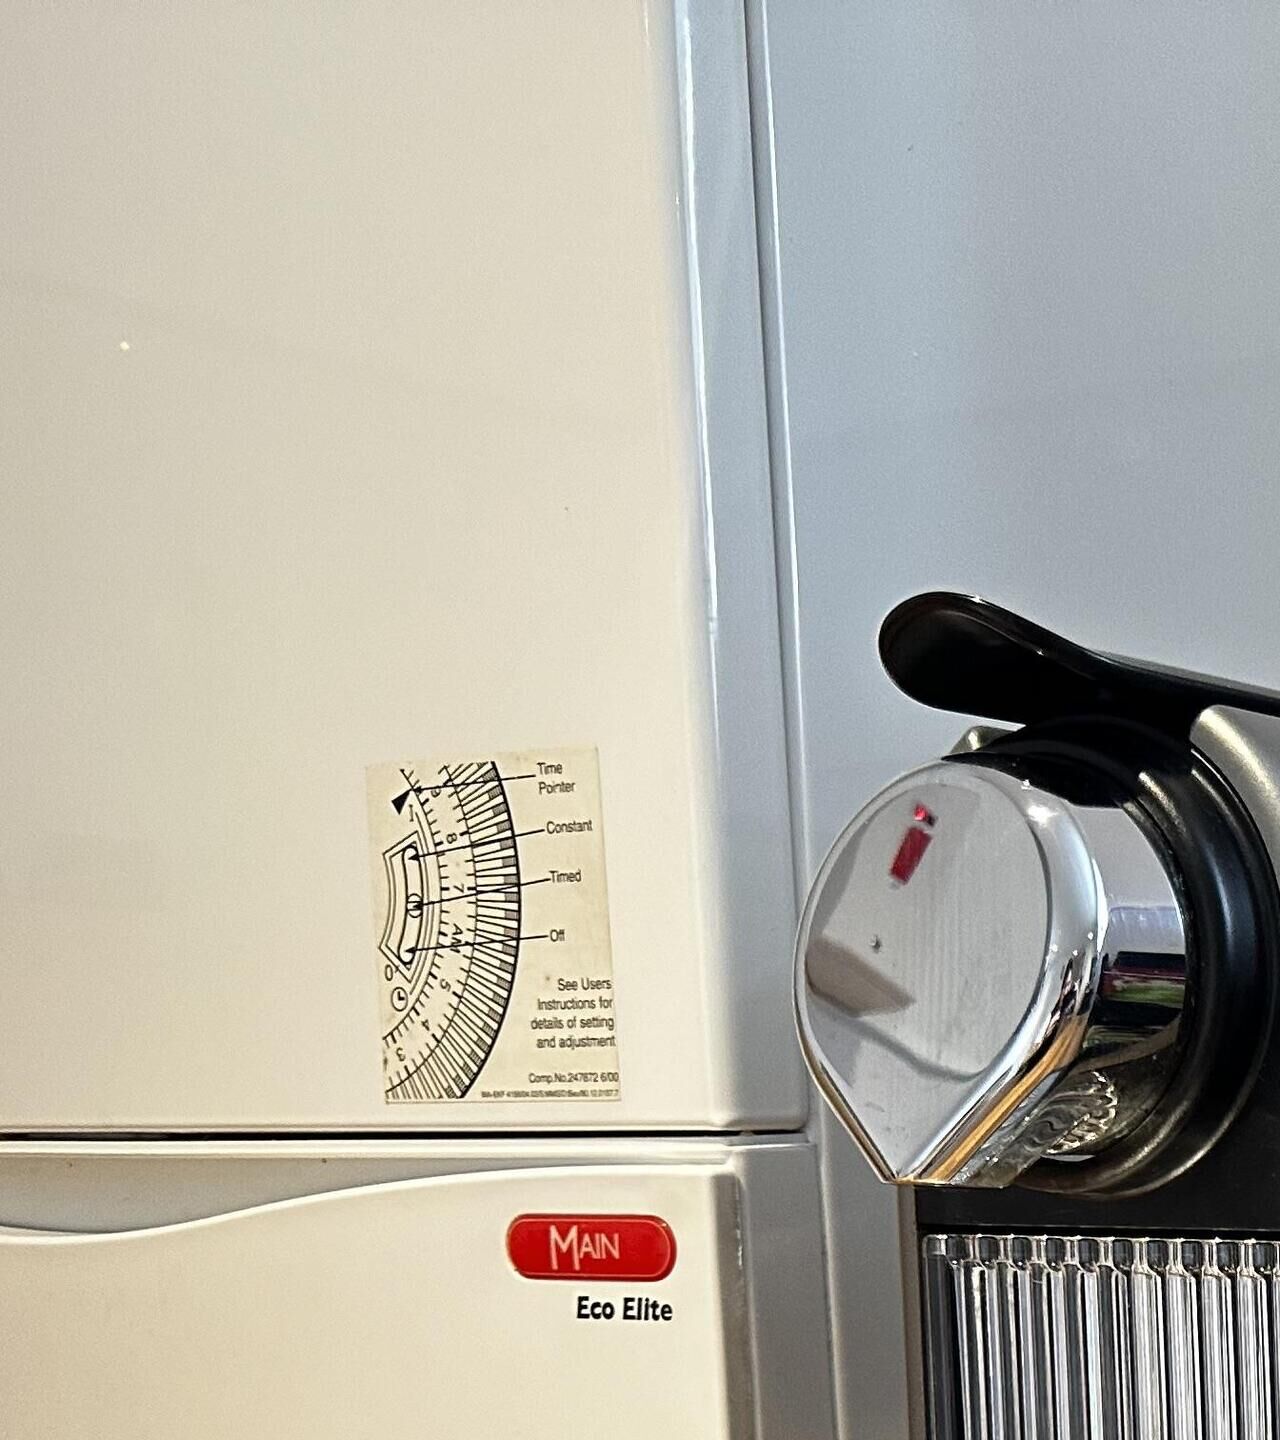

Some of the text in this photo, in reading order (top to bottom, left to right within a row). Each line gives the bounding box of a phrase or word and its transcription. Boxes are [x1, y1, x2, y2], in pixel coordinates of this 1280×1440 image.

[537, 762, 563, 775] Time
[538, 780, 576, 795] Pointer
[546, 819, 593, 834] Constant
[446, 833, 458, 844] 8
[549, 868, 582, 883] Timed
[453, 883, 465, 893] 7
[550, 929, 566, 942] Off
[439, 978, 452, 992] 5
[558, 977, 612, 991] See Users
[537, 995, 613, 1010] Instructions for
[420, 1018, 431, 1032] 4
[530, 1016, 614, 1031] details of setting
[537, 1034, 616, 1050] and adjustment
[395, 1047, 406, 1061] 3
[576, 1296, 673, 1321] Eco Elite
